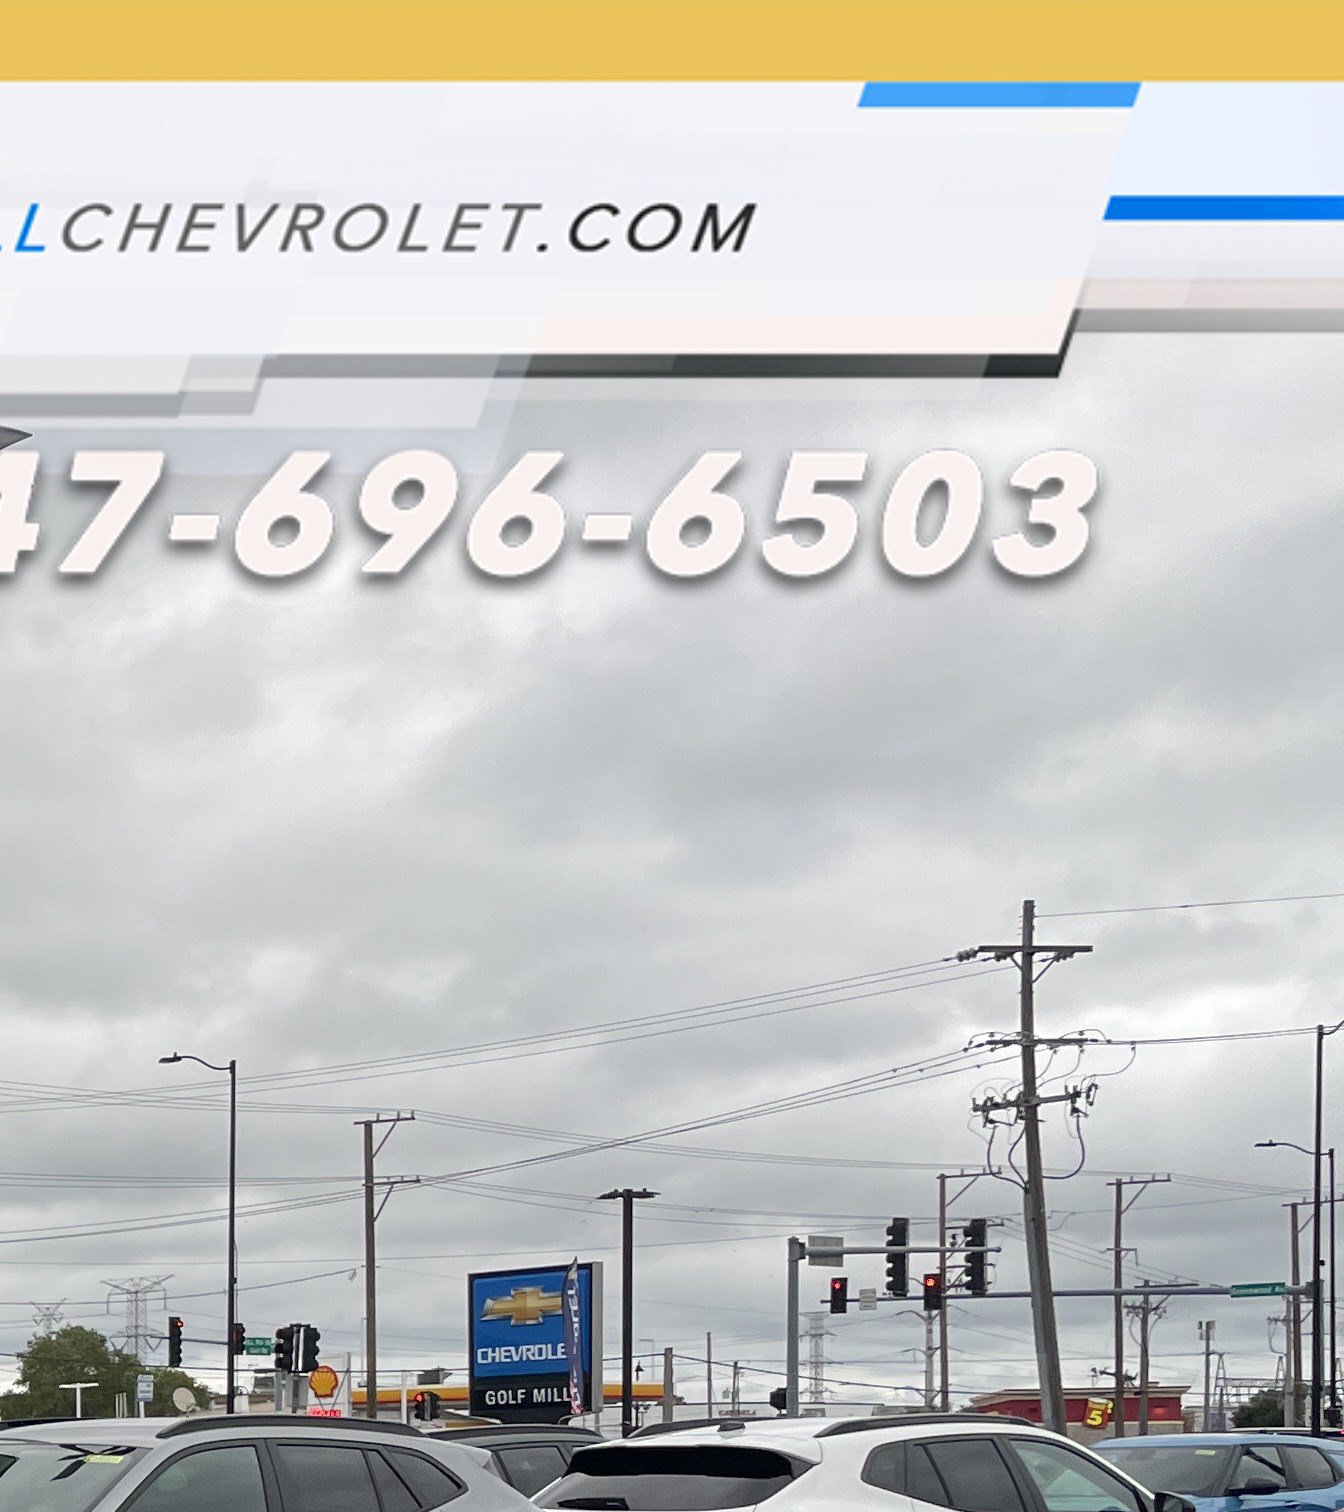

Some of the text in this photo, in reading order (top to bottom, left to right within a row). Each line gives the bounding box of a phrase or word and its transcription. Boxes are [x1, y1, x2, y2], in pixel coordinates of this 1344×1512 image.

[477, 1342, 567, 1364] CHEVROLE
[485, 1387, 572, 1406] GOLF MILL
